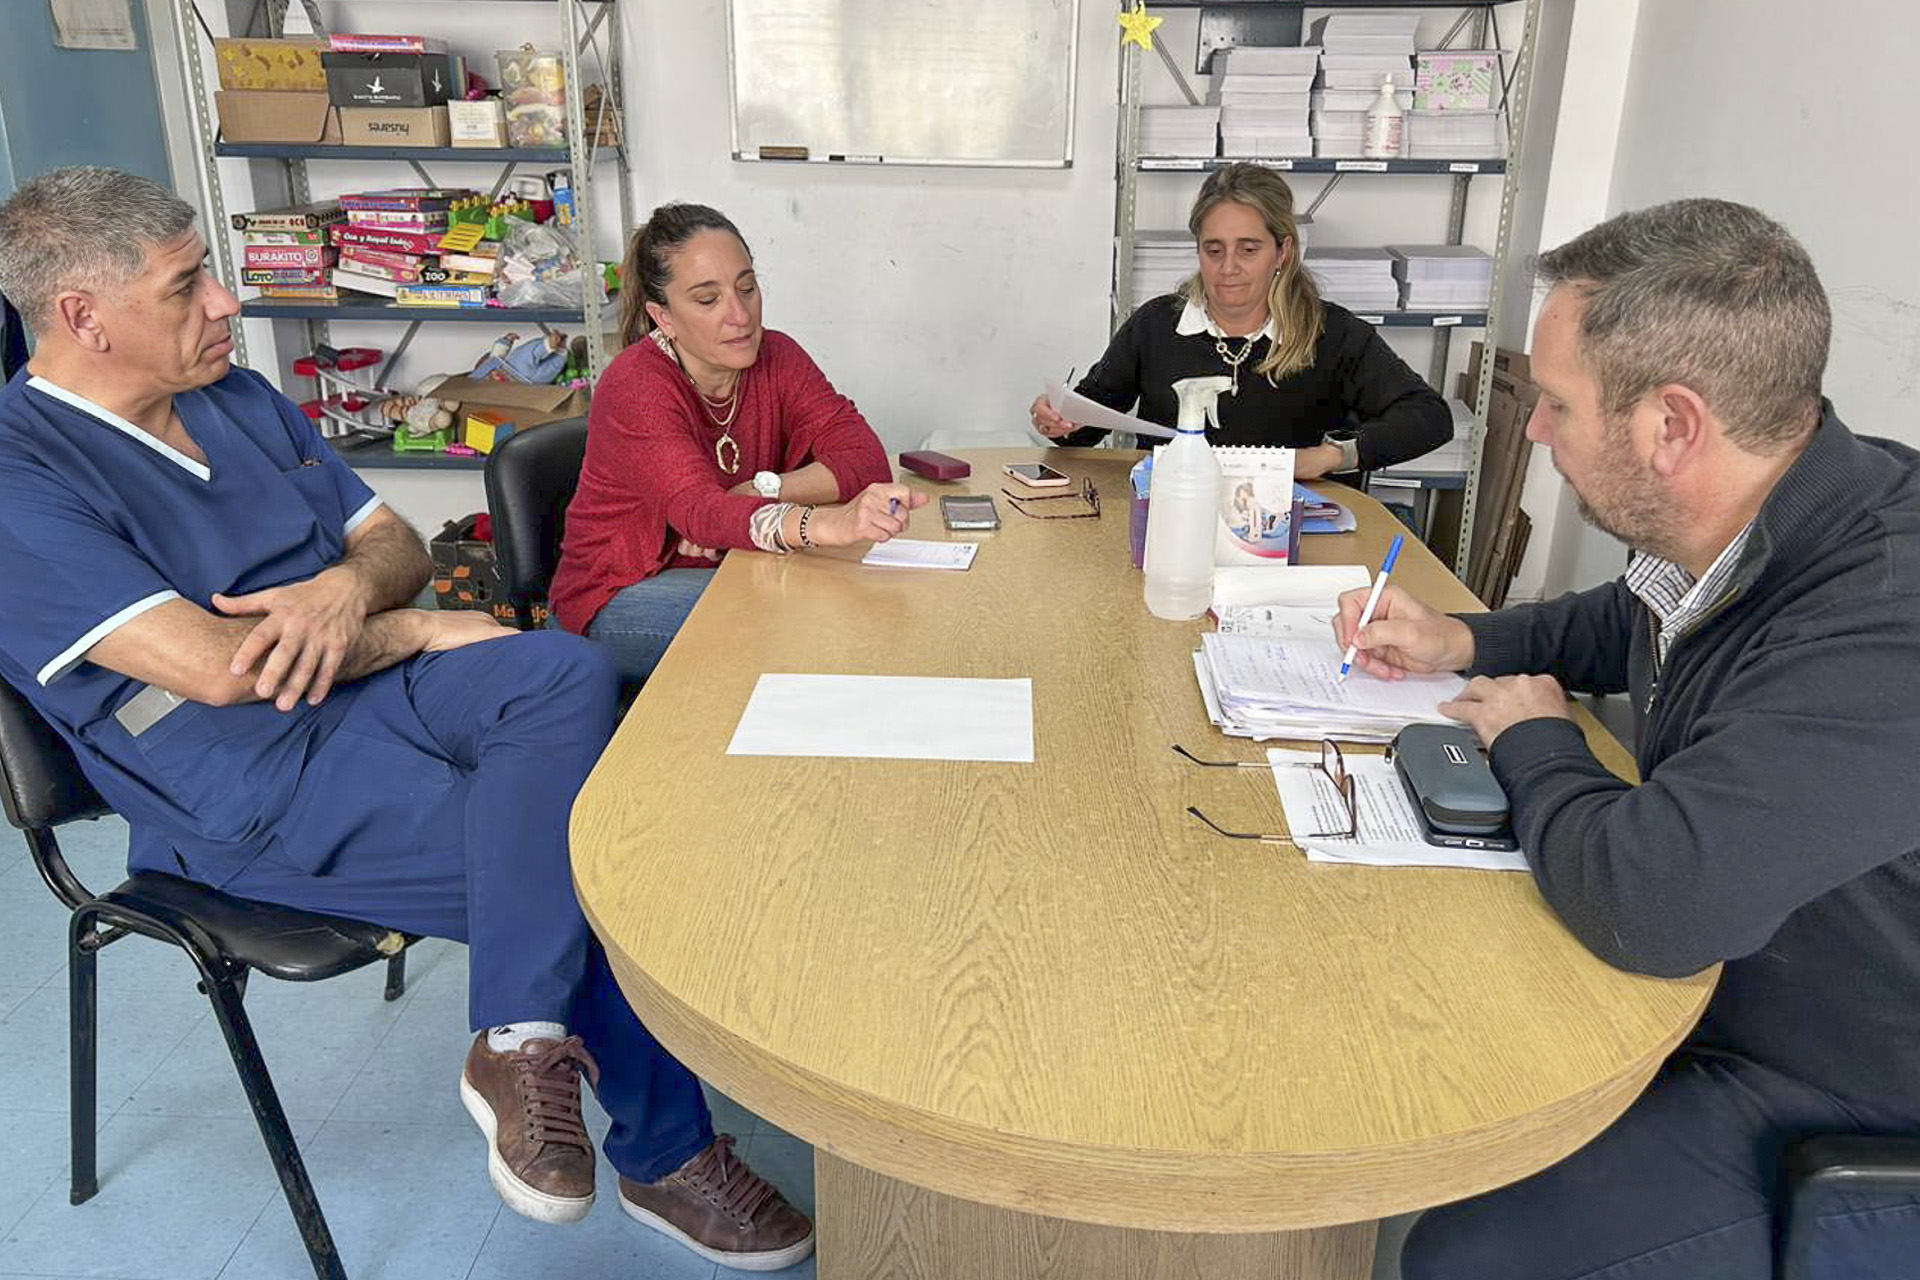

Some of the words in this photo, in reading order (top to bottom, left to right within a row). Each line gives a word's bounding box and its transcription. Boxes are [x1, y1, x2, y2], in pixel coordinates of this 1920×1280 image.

[248, 252, 303, 262] BURAKITO
[246, 269, 274, 282] LOTO
[425, 272, 446, 281] ZOO
